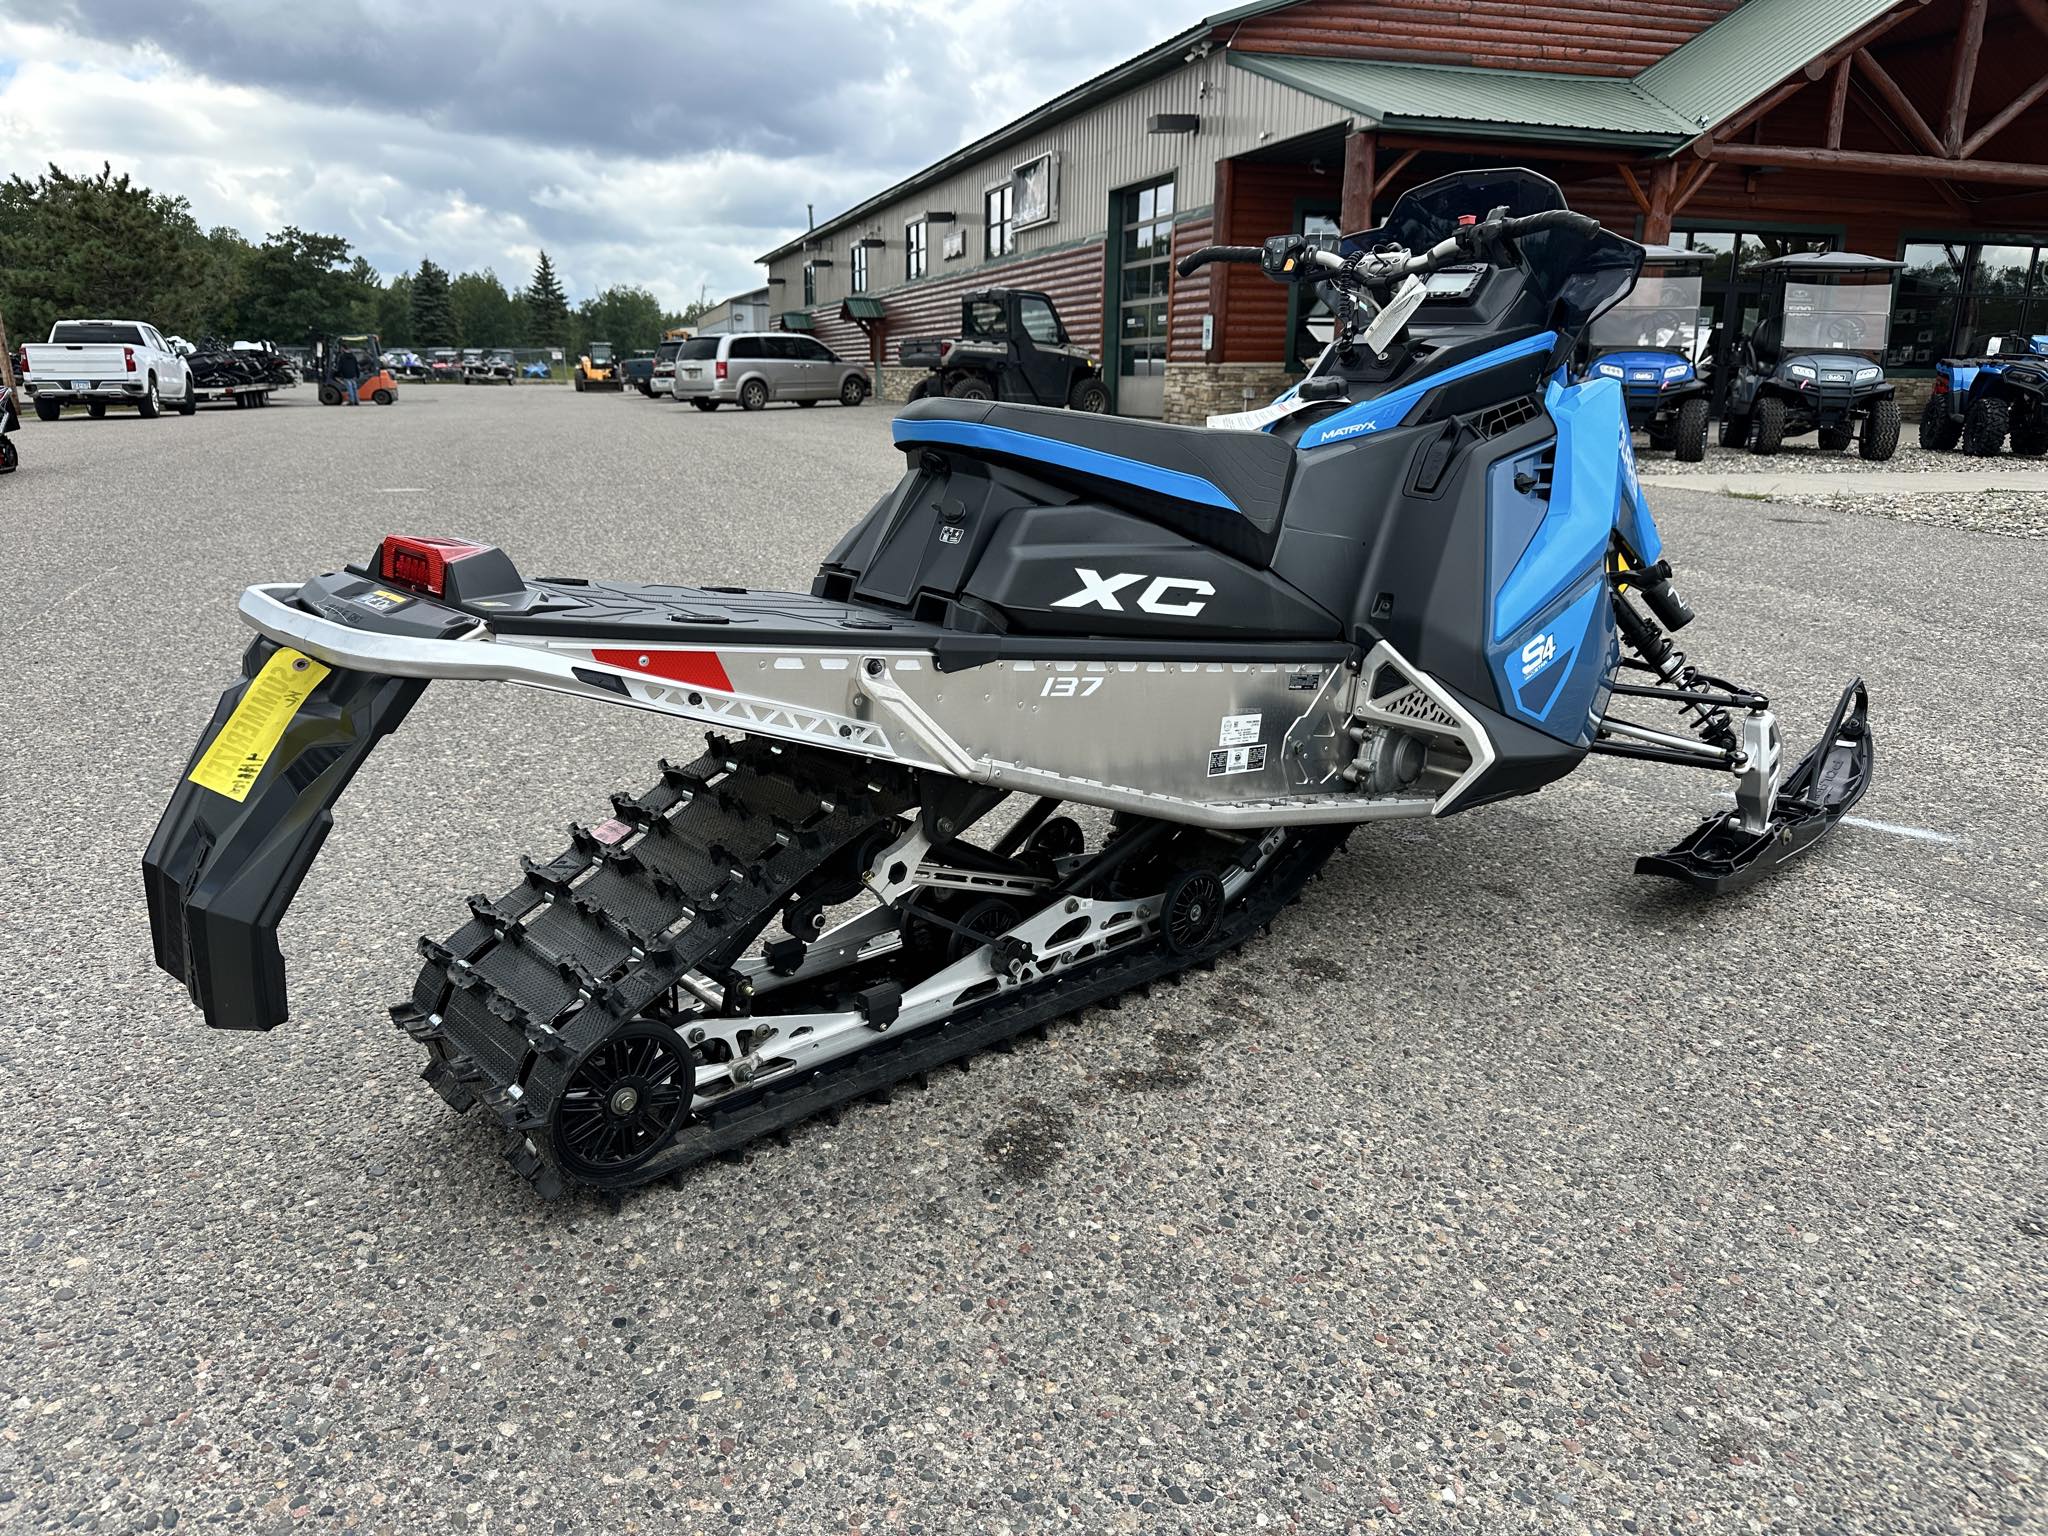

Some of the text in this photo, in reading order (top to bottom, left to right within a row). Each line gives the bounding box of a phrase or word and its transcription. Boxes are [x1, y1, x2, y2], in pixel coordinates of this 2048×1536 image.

[1320, 421, 1377, 442] MATRYX
[1050, 567, 1217, 617] XC
[1521, 632, 1557, 675] S4
[1040, 677, 1105, 697] 137
